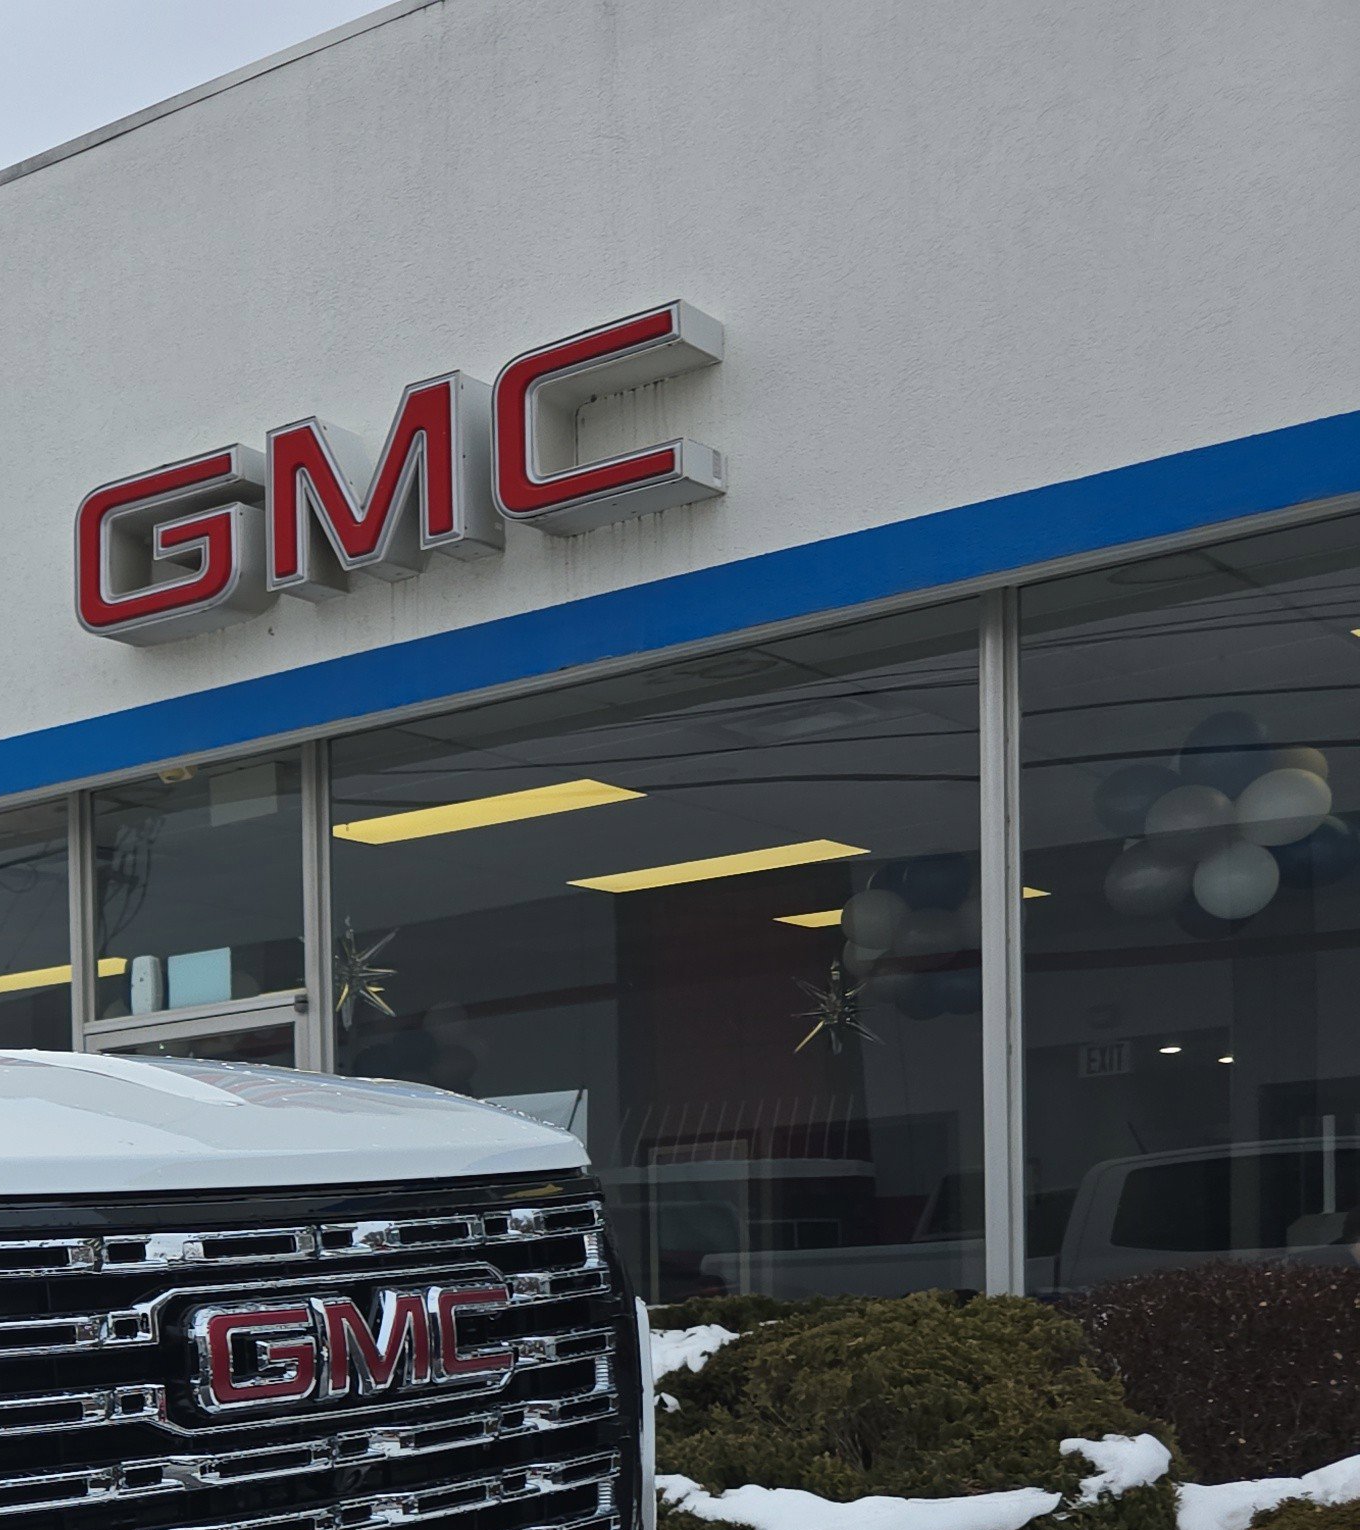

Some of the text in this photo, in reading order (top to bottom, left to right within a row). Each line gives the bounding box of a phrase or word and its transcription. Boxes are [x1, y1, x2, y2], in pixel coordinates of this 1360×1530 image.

[75, 299, 692, 638] GMC
[1087, 1043, 1125, 1074] EXIT
[194, 1282, 516, 1412] GMC
